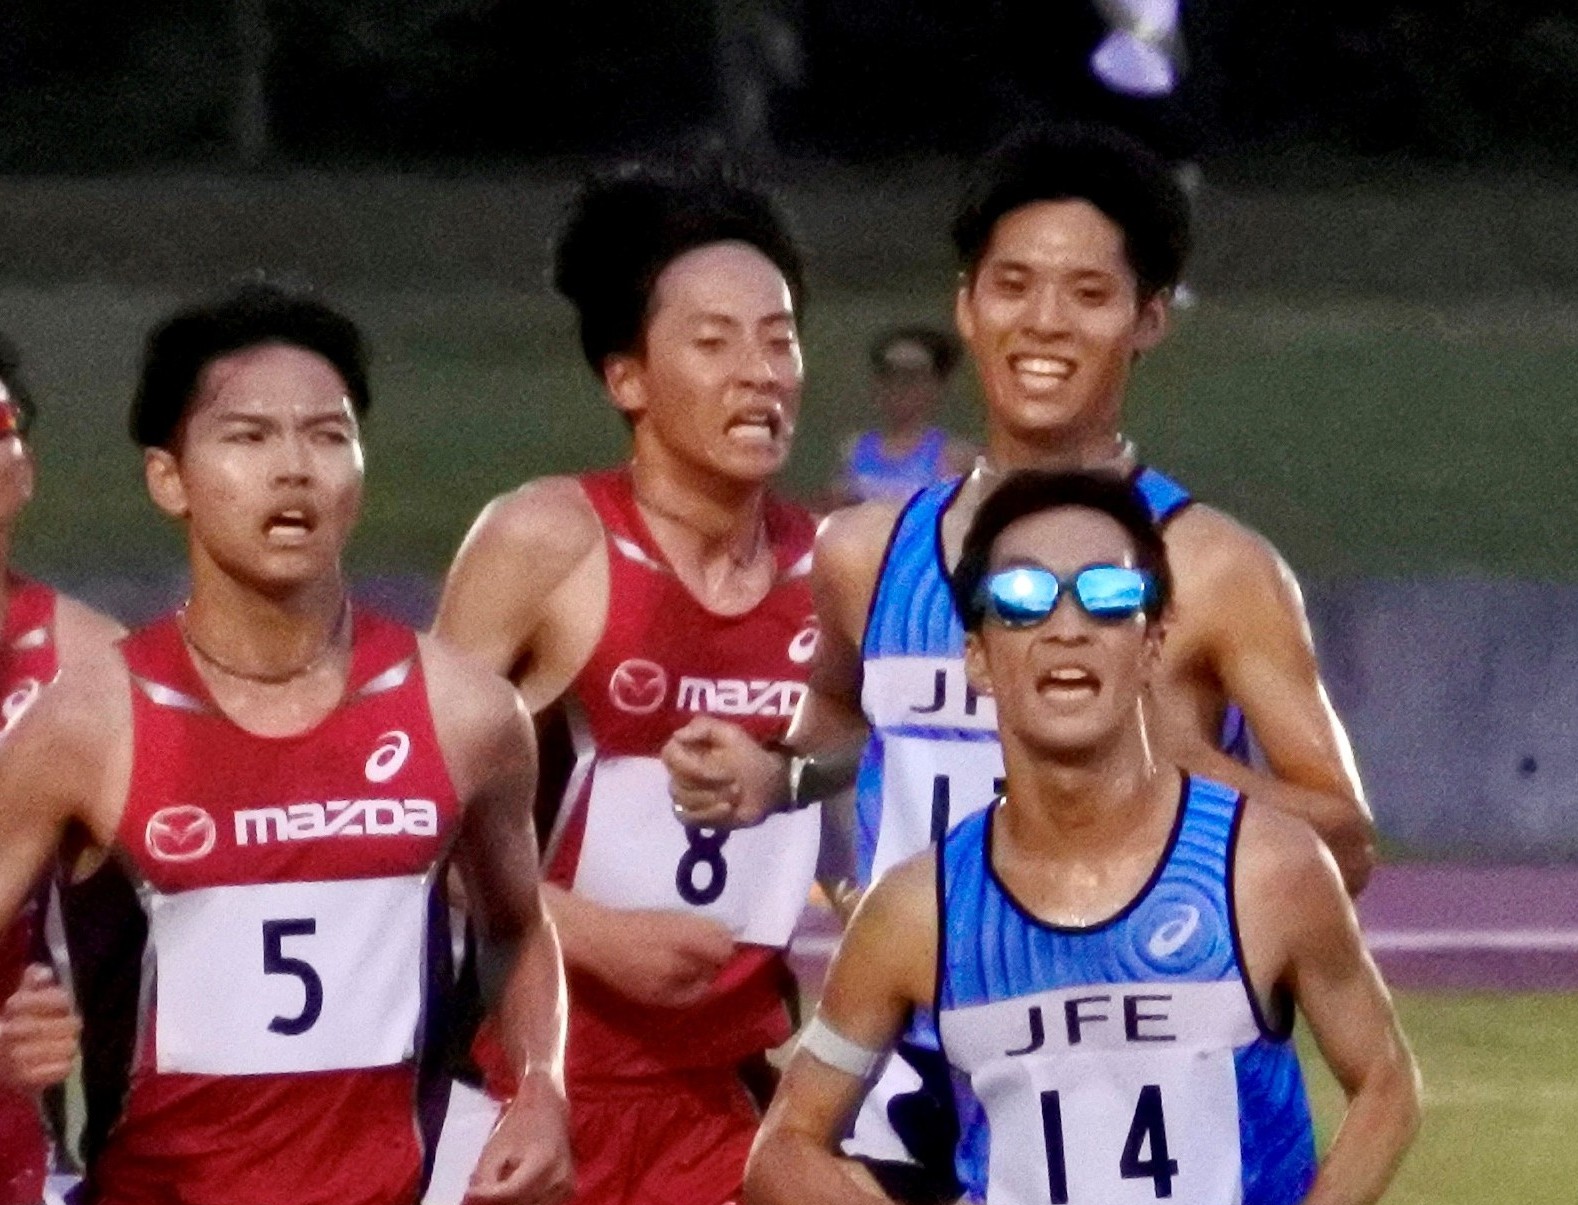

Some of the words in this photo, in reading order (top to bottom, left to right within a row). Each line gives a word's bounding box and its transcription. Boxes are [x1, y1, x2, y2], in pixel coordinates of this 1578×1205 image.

[931, 774, 1008, 844] 1
[675, 825, 727, 905] 8
[262, 918, 324, 1036] 5
[1005, 994, 1176, 1057] JFE
[1040, 1084, 1179, 1205] 14
